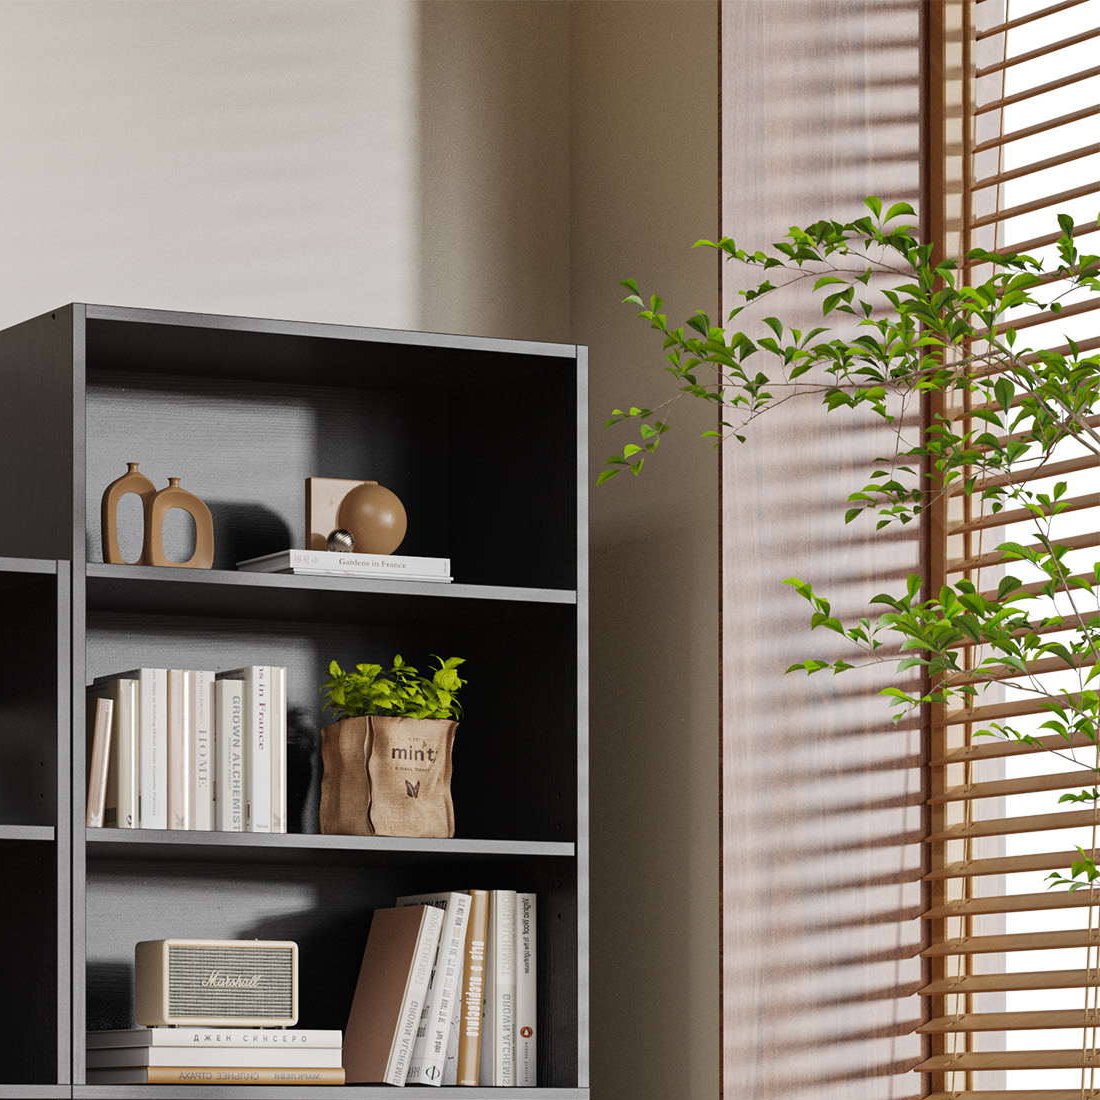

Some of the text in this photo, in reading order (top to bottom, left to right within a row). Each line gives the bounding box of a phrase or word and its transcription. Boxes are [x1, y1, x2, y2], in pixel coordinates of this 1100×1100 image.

[339, 558, 370, 567] Gardens
[381, 560, 407, 569] France
[259, 684, 266, 697] in
[258, 702, 266, 750] France
[199, 730, 207, 788] HOME
[391, 745, 435, 762] mint
[232, 695, 241, 832] GROWN ALCHEMIST
[201, 969, 262, 988] Marshall
[193, 1034, 308, 1043] ДЖЕН СИНСЕРО
